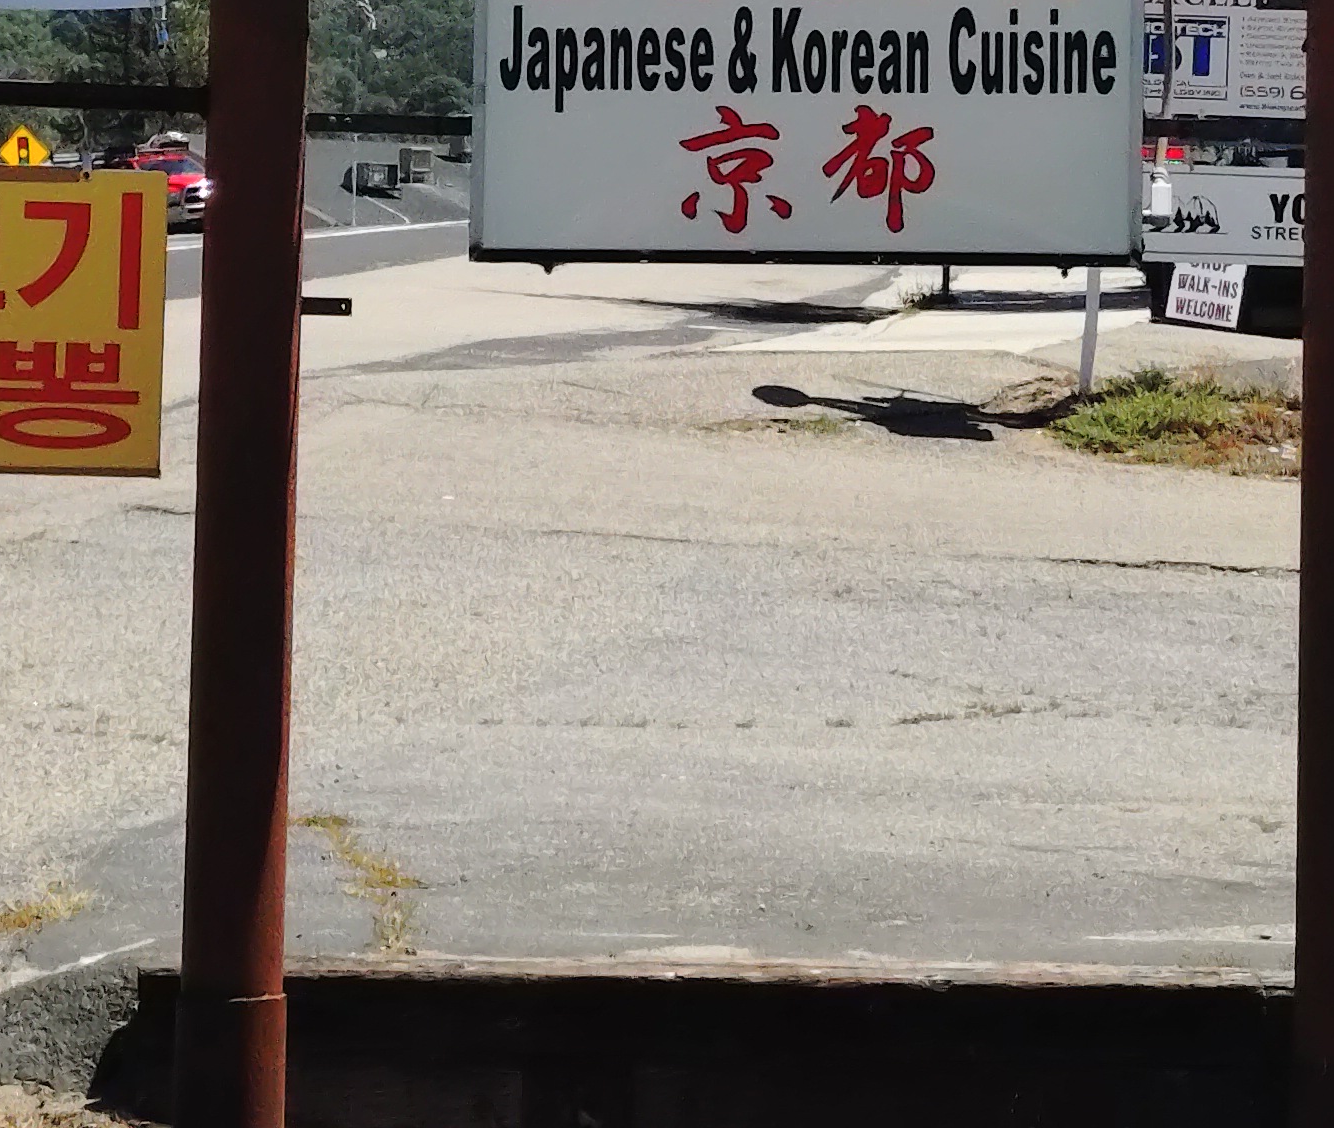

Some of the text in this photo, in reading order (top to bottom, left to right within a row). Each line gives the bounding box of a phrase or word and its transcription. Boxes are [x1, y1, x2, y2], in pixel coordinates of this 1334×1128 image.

[499, 4, 715, 112] Japanese
[728, 6, 758, 93] &
[771, 6, 931, 94] Korean
[948, 6, 1118, 95] Cuisine
[679, 104, 937, 234] 京都
[1175, 297, 1234, 322] WELCOME
[1178, 274, 1239, 299] WALK-INS
